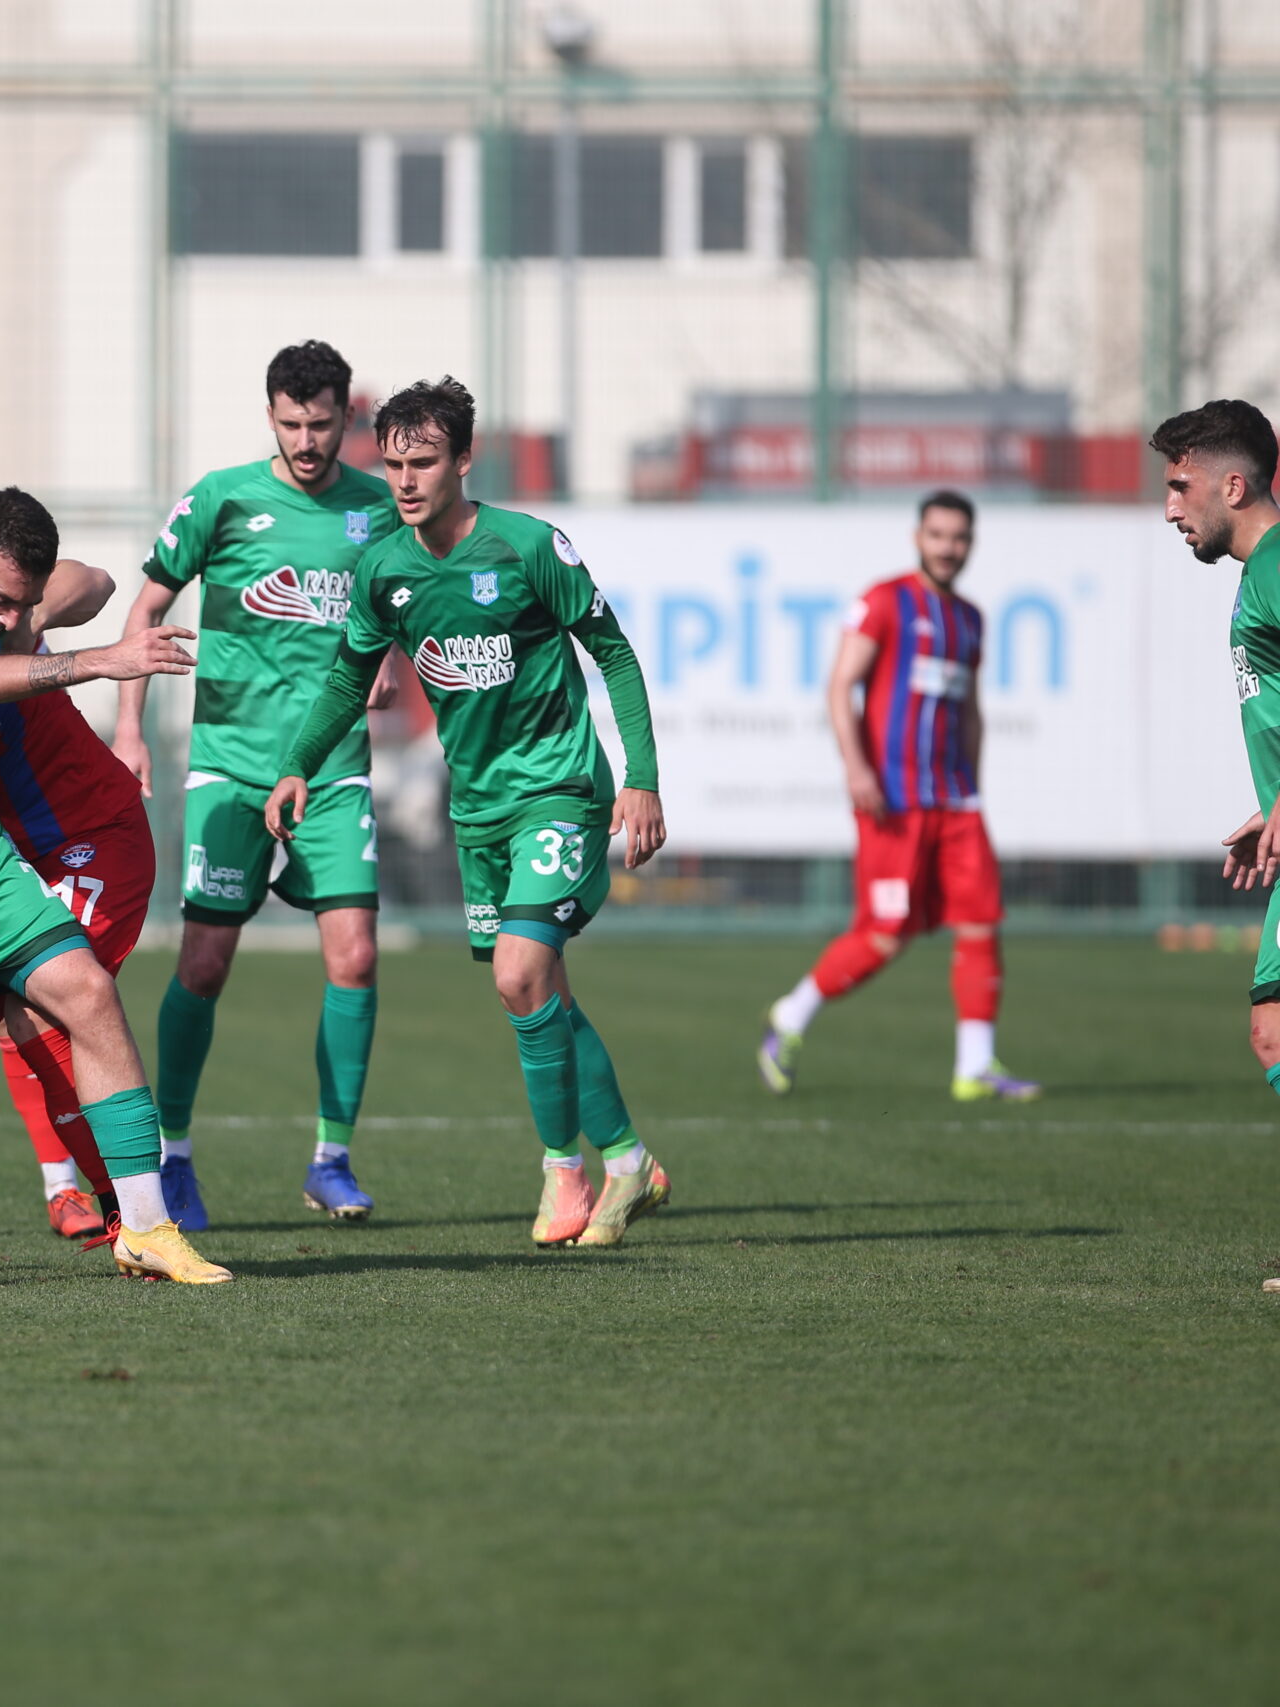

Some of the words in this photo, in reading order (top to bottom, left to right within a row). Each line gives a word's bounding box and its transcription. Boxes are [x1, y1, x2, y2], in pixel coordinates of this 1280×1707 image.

[305, 570, 353, 598] KARA
[446, 635, 511, 662] KARASU
[531, 829, 585, 881] 33
[51, 875, 104, 926] 17
